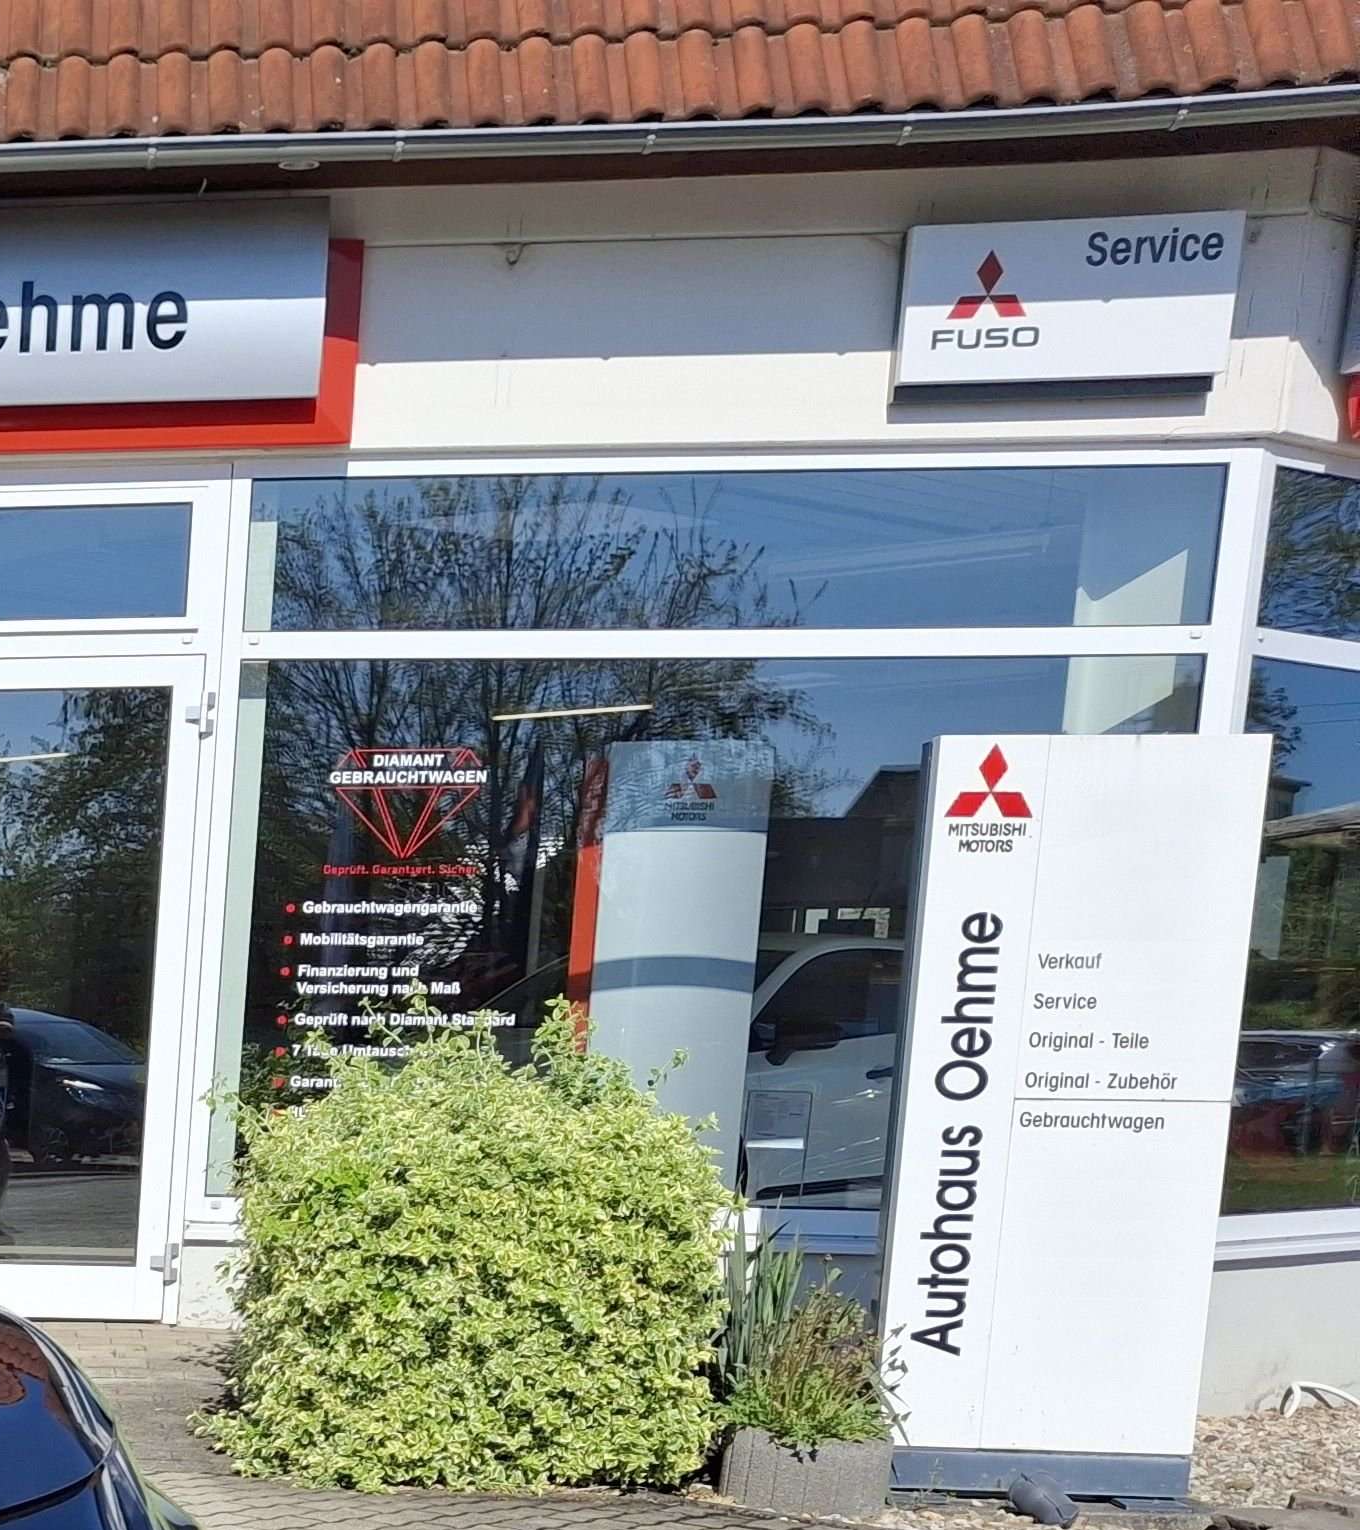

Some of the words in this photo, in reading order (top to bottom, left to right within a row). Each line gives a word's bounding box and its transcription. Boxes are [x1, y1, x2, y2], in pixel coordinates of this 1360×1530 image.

[1086, 227, 1223, 266] Service
[931, 326, 1039, 350] FUSO
[373, 754, 445, 767] DIAMANT
[330, 770, 487, 784] GEBRAUCHTWAGEN
[948, 823, 1027, 836] MITSUBISHI
[958, 839, 1013, 852] MOTORS
[302, 901, 478, 916] Gebrauchtwagengarantie
[300, 932, 424, 947] Mobilitätsgarantie
[1038, 953, 1103, 969] Verkauf
[297, 964, 388, 979] Finanzierung
[392, 964, 420, 977] und
[296, 982, 388, 996] Versicherung
[432, 982, 461, 994] Maß
[935, 911, 1003, 1102] Oehme
[1033, 993, 1097, 1009] Service
[294, 1013, 348, 1028] Geprüft
[390, 1013, 448, 1026] Diamant
[1029, 1032, 1094, 1052] Original
[1112, 1032, 1150, 1049] Teile
[292, 1044, 301, 1057] 7
[1025, 1072, 1090, 1092] Original
[1107, 1072, 1178, 1089] Zubehör
[1020, 1112, 1165, 1133] Gebrauchtwagen
[910, 1126, 984, 1357] Autohaus
